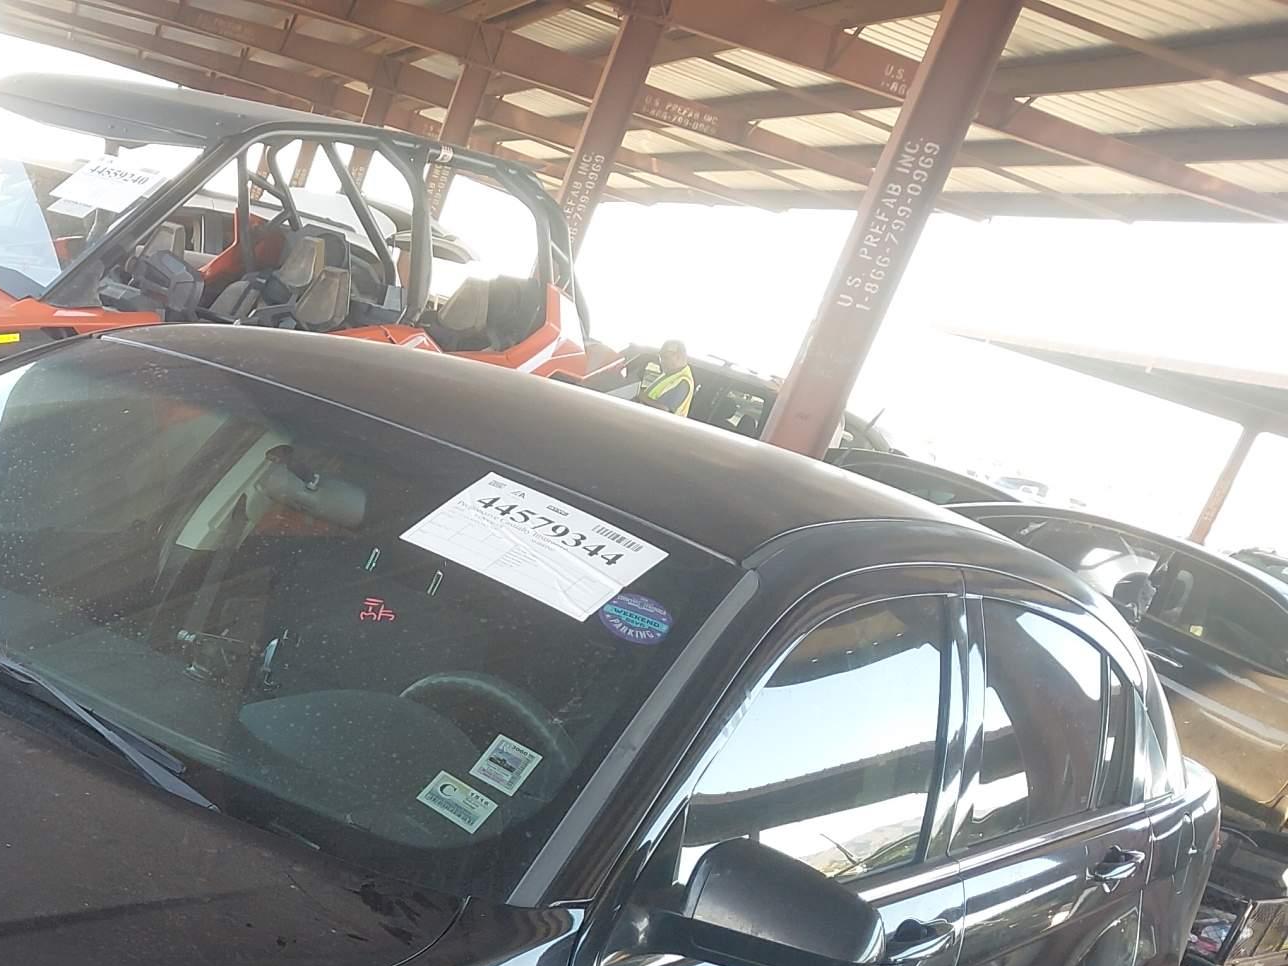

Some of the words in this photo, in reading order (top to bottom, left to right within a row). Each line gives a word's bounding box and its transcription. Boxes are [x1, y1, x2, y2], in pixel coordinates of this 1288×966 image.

[859, 182, 903, 260] PREFAB
[896, 136, 925, 175] INC.
[855, 141, 941, 312] 1-866-799-0969
[475, 495, 625, 566] 44579344
[609, 618, 655, 639] PARKING
[614, 607, 660, 628] WEEKEND
[439, 783, 457, 796] C
